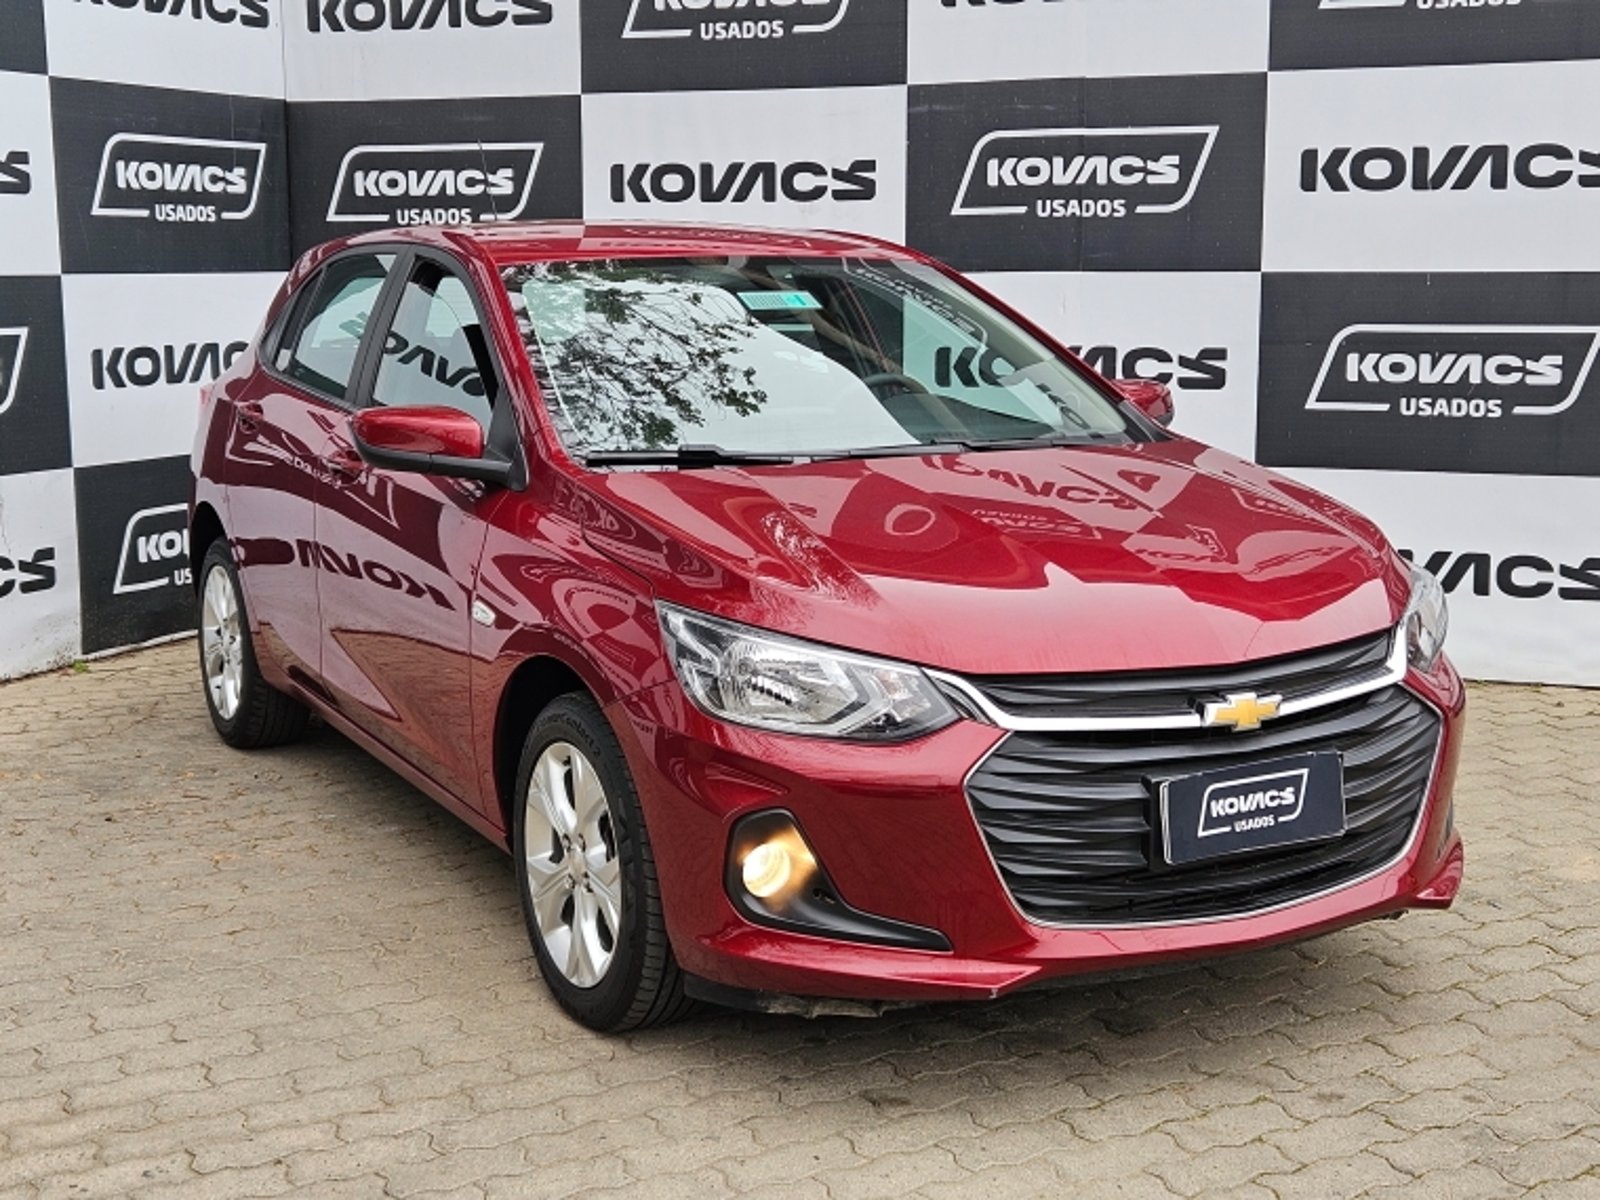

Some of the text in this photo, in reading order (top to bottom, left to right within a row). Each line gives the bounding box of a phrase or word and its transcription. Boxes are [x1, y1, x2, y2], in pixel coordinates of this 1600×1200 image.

[700, 20, 784, 40] USADOS
[115, 160, 247, 194] KOVACS
[354, 168, 514, 197] KOVACS
[610, 159, 876, 202] KOVACS
[986, 155, 1180, 187] KOVACS
[154, 203, 216, 222] USADOS
[396, 208, 472, 226] USADOS
[1036, 199, 1127, 218] USADOS
[1345, 352, 1563, 386] KOVACS
[1399, 397, 1502, 418] USADOS
[1210, 787, 1296, 818] KOVACS
[1234, 814, 1275, 832] USADOS
